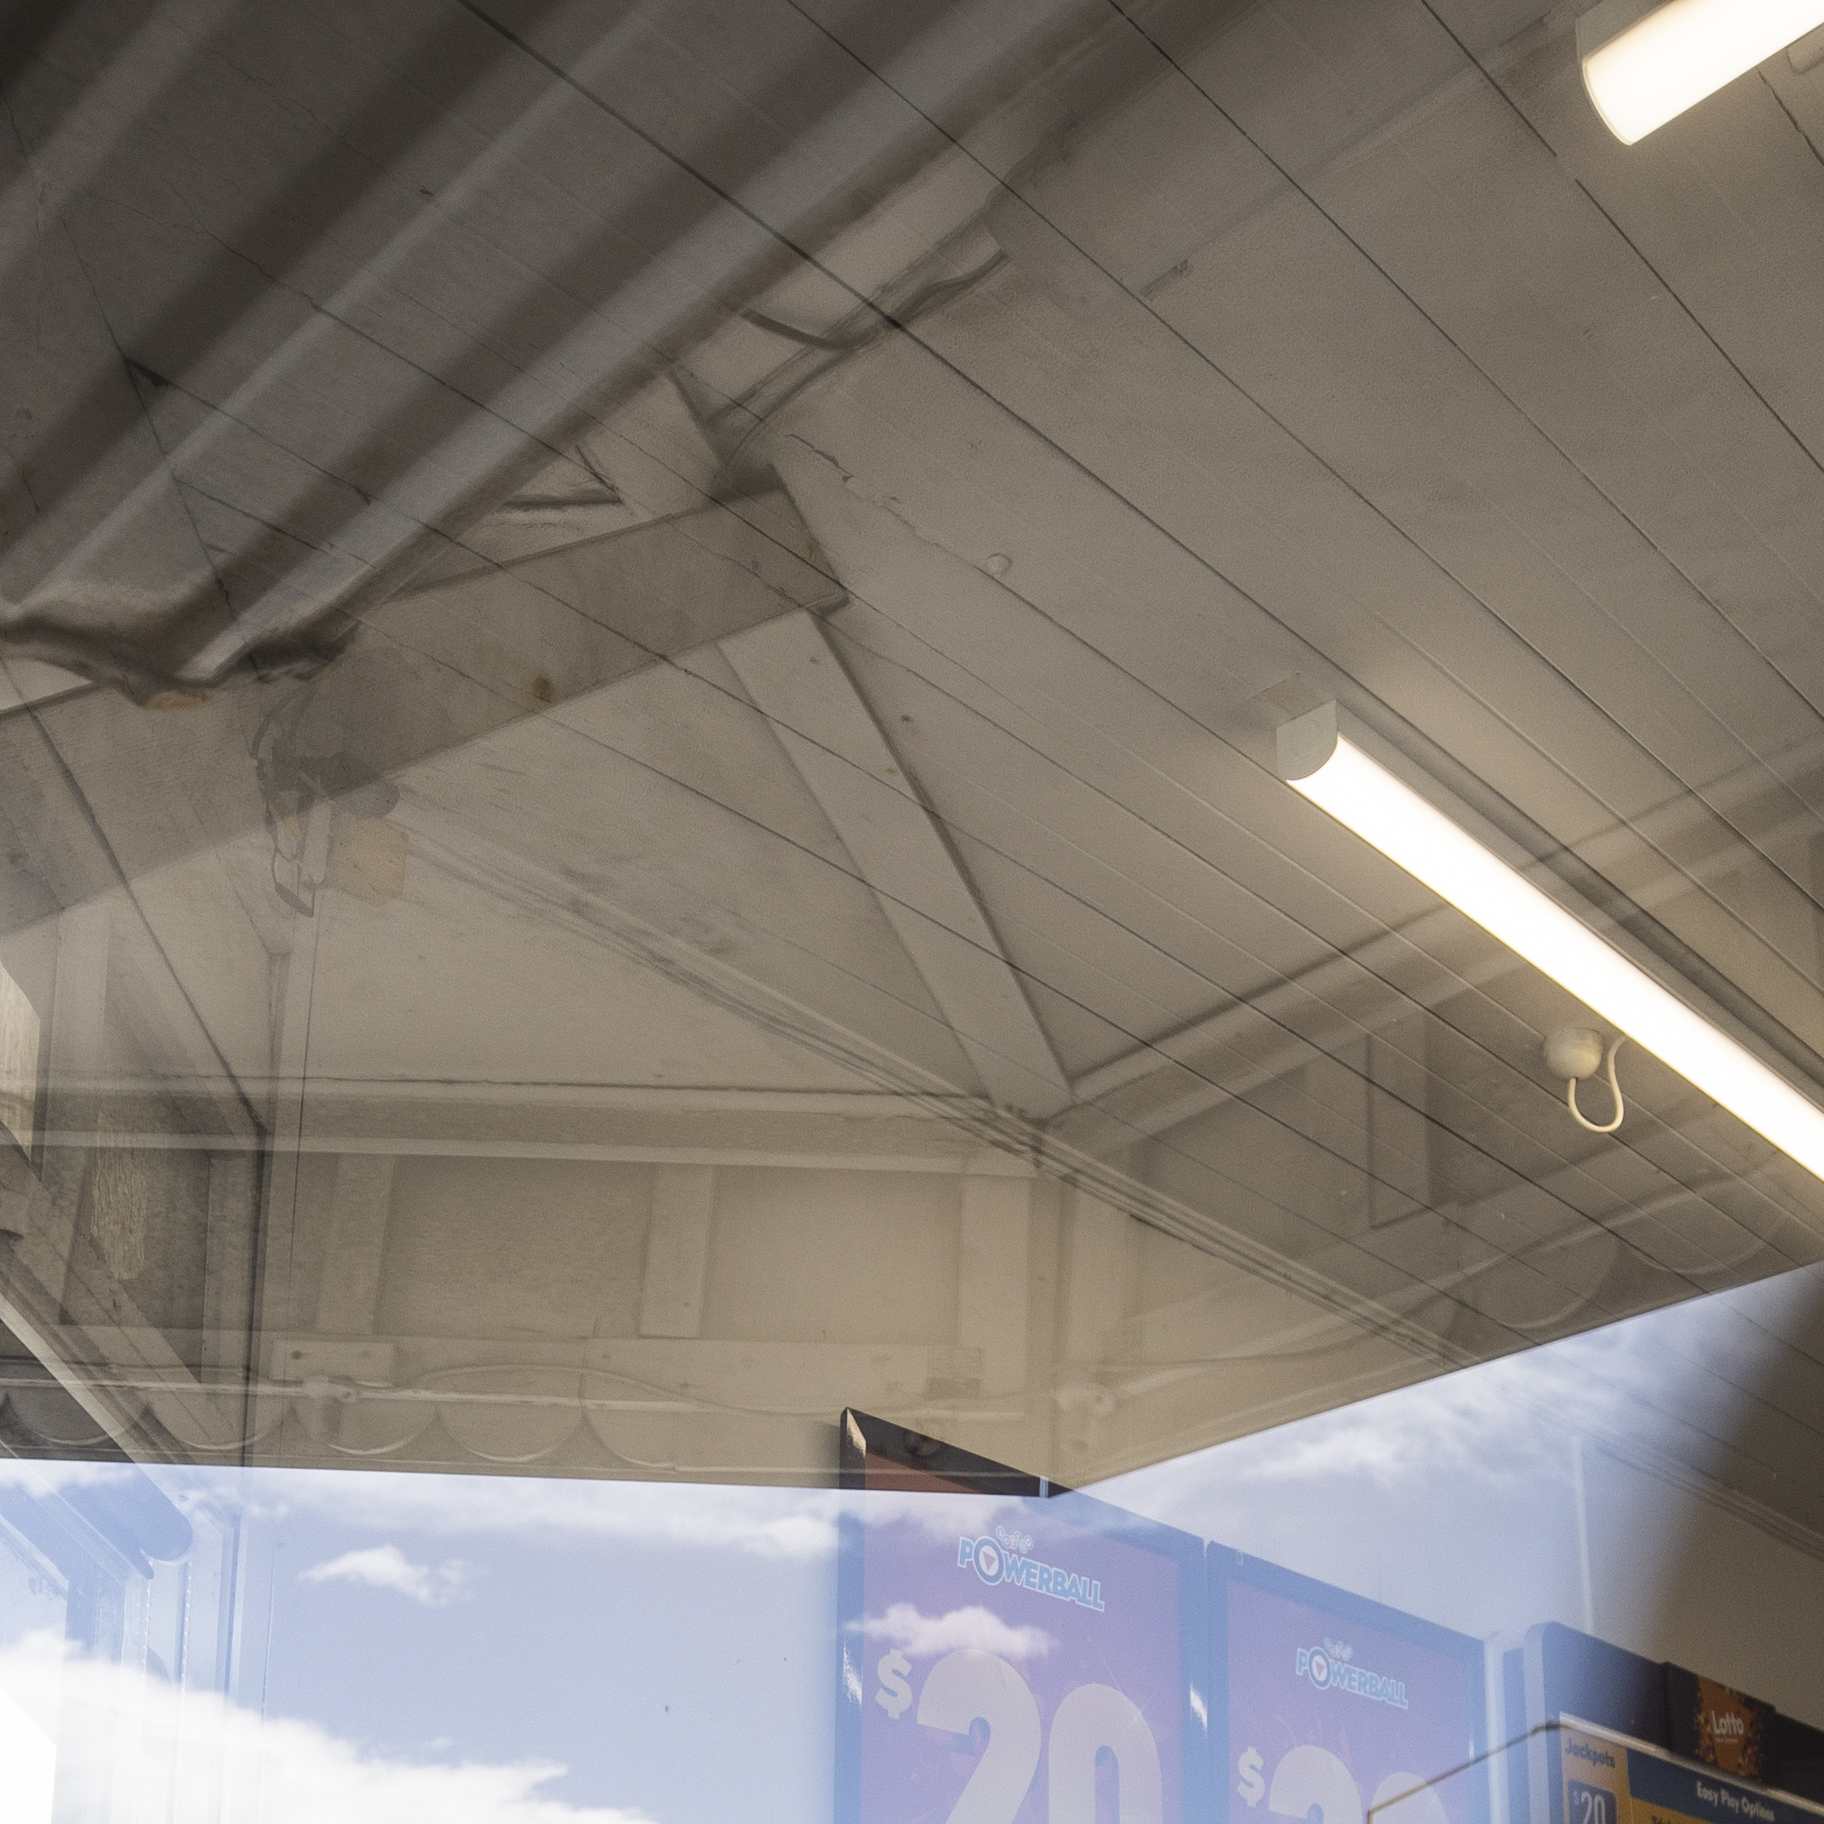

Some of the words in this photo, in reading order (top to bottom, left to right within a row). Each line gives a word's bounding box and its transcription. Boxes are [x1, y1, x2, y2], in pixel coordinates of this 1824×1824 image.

[957, 1535, 1105, 1613] POWERBALL
[1296, 1646, 1409, 1709] POWERBALL
[1711, 1710, 1745, 1736] Lotto
[1565, 1739, 1616, 1768] Jackpots
[1696, 1781, 1719, 1806] Easy
[1721, 1789, 1740, 1814] Play
[1741, 1797, 1775, 1822] Options
